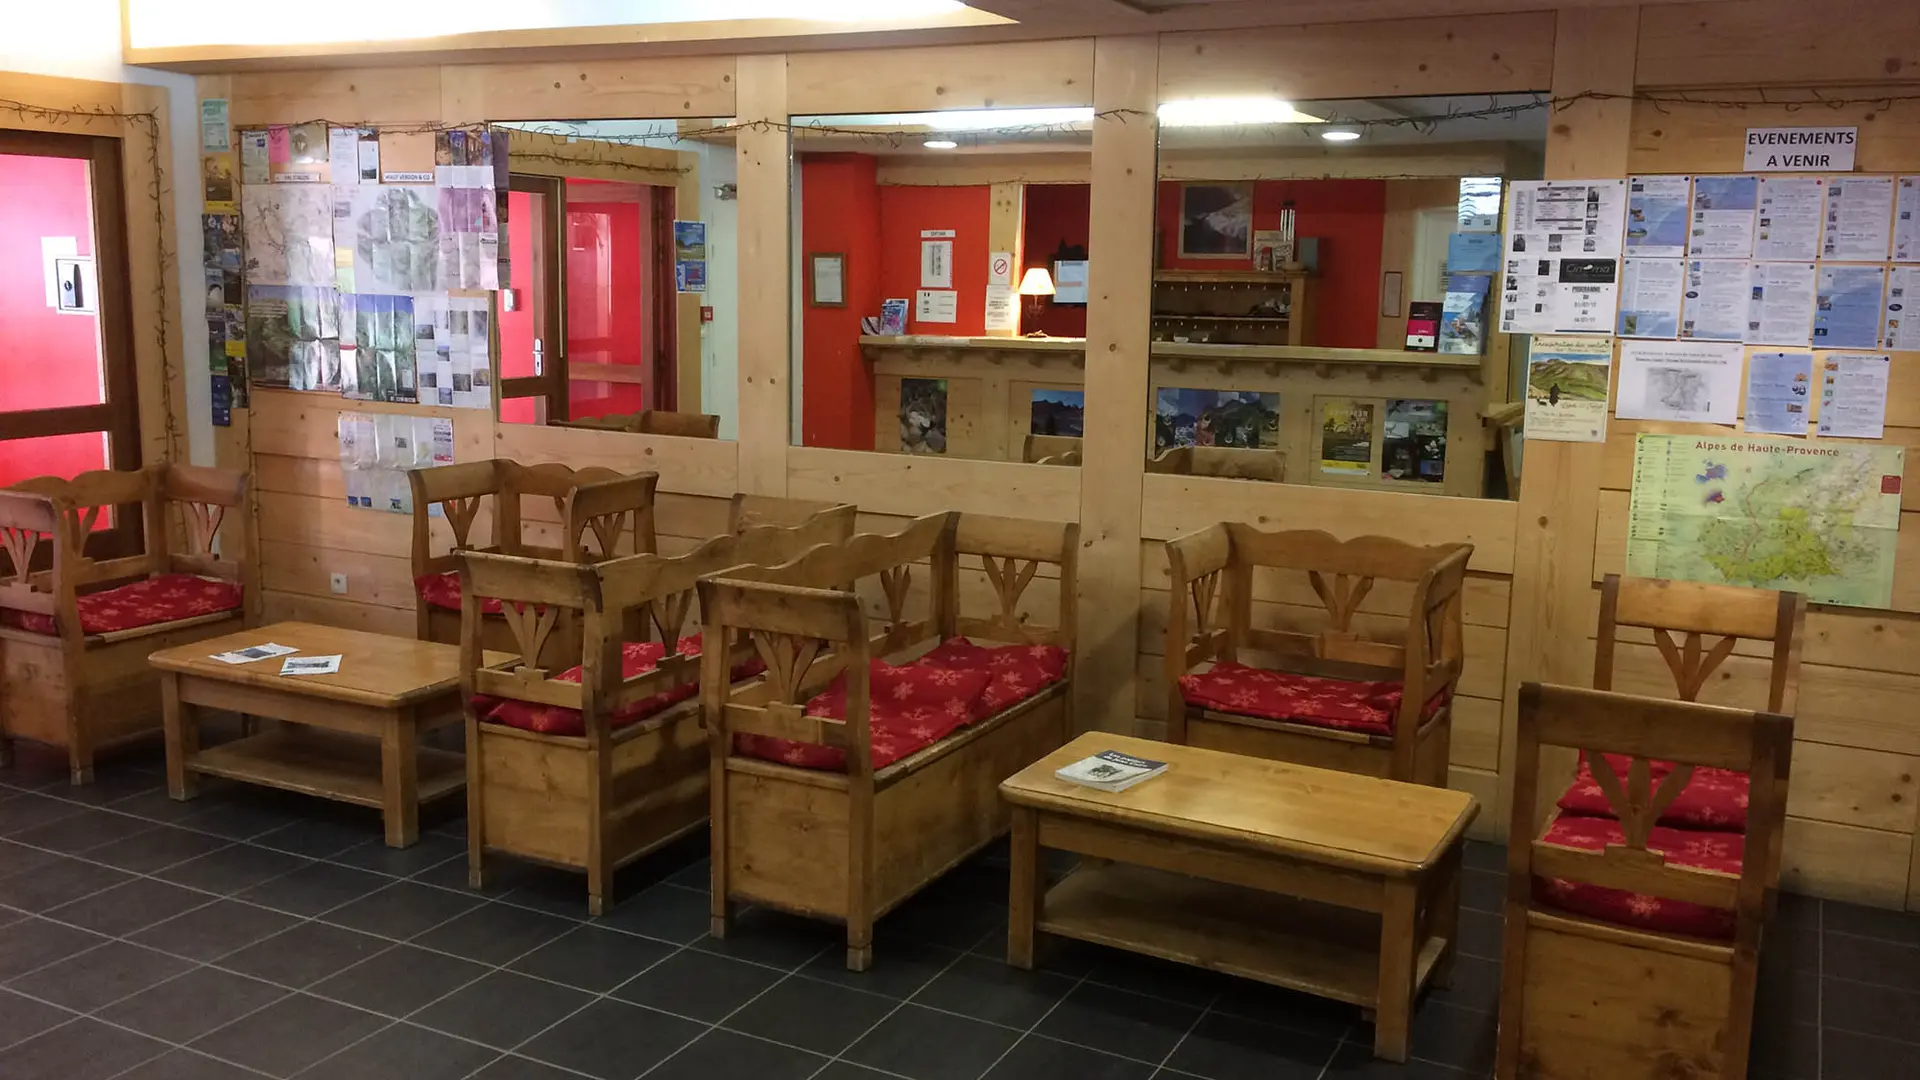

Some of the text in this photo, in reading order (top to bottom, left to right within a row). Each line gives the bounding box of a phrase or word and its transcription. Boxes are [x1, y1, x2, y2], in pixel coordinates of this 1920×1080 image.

[1748, 132, 1855, 145] EVENEMENTS
[1766, 154, 1830, 167] A VENIR
[1566, 264, 1611, 273] Cinma
[1695, 441, 1840, 457] Alpes de Haute-Provence
